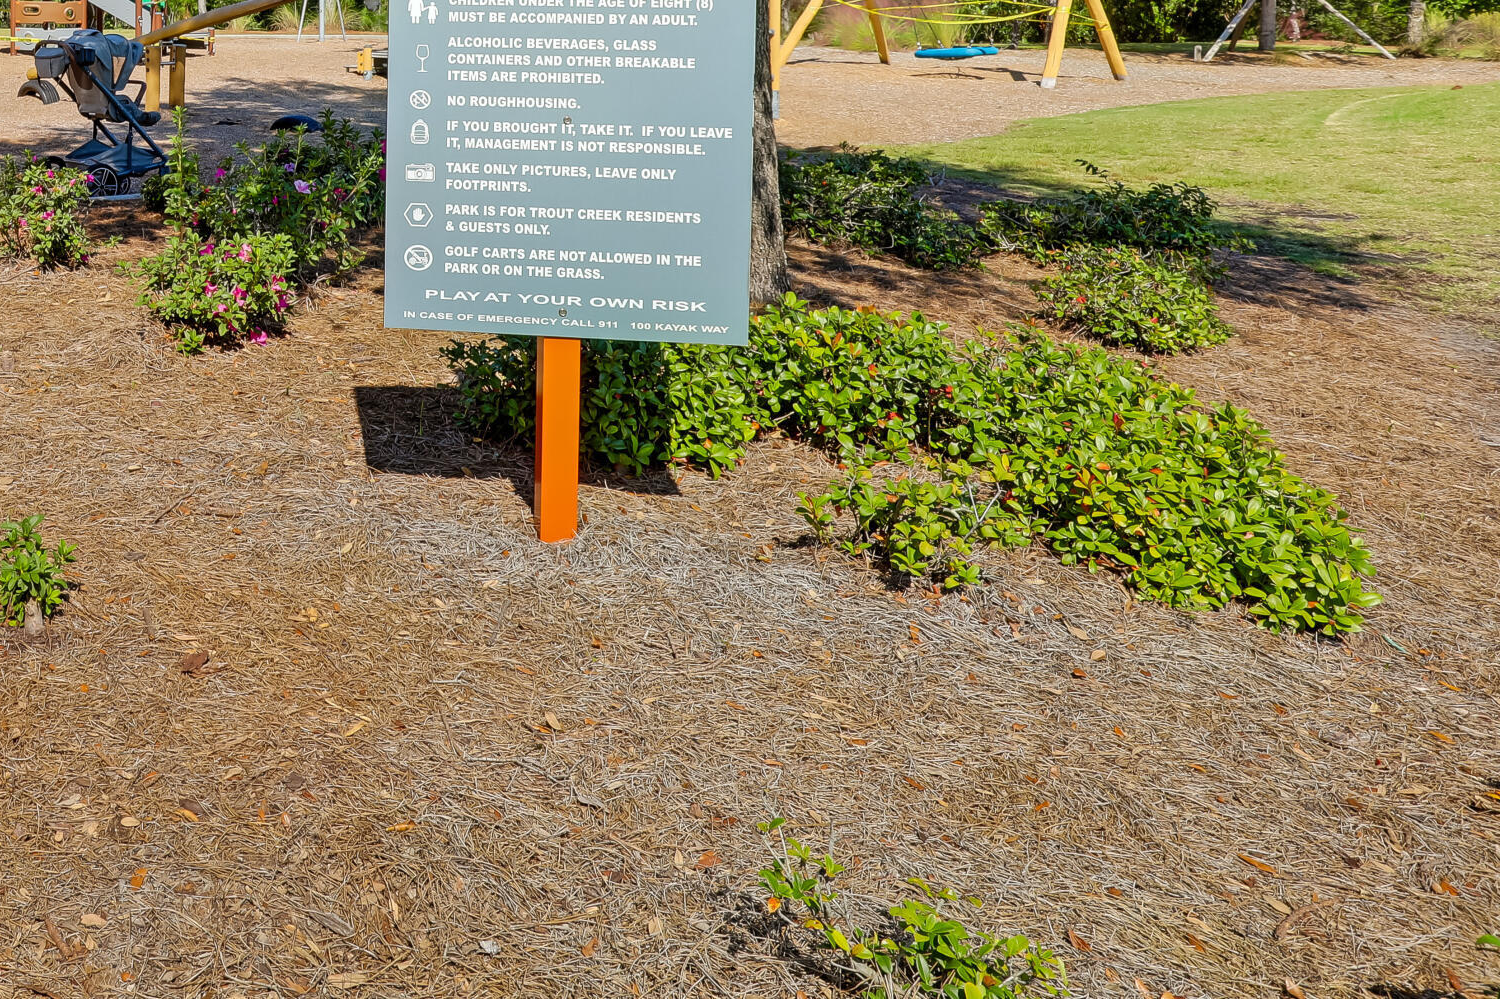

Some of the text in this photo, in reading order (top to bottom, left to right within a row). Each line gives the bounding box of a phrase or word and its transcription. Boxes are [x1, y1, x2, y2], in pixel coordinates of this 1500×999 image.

[448, 11, 698, 26] MUST BE ACCOMPANIED BY AN ADULT.
[447, 36, 657, 53] ALCOHOLIC BEVERAGES, GLASS
[447, 52, 696, 69] CONTAINERS AND OTHER BREAKABLE
[447, 69, 605, 85] ITEMS ARE PROHIBITED.
[447, 95, 581, 110] NO ROUGHHOUSING.
[446, 120, 733, 139] IF YOU BROUGHT IT, TAKE IT. IF YOU LEAVE
[446, 136, 706, 156] IT, MANAGEMENT IS NOT RESPONSIBLE.
[445, 161, 677, 181] TAKE ONLY PICTURES, LEAVE ONLY
[445, 178, 532, 193] FOOTPRINTS.
[445, 203, 702, 224] PARK IS FOR TROUT CREEK RESIDENTS
[445, 220, 551, 236] & GUESTS ONLY.
[444, 245, 702, 267] GOLF CARTS ARE NOT ALLOWED IN THE
[444, 262, 605, 280] PARK OR ON THE GRASS.
[425, 289, 707, 313] PLAY AT YOUR OWN RISK
[403, 310, 730, 334] IN CASE OF EMERGENCY CALL 911 100 KAYAK WAY
